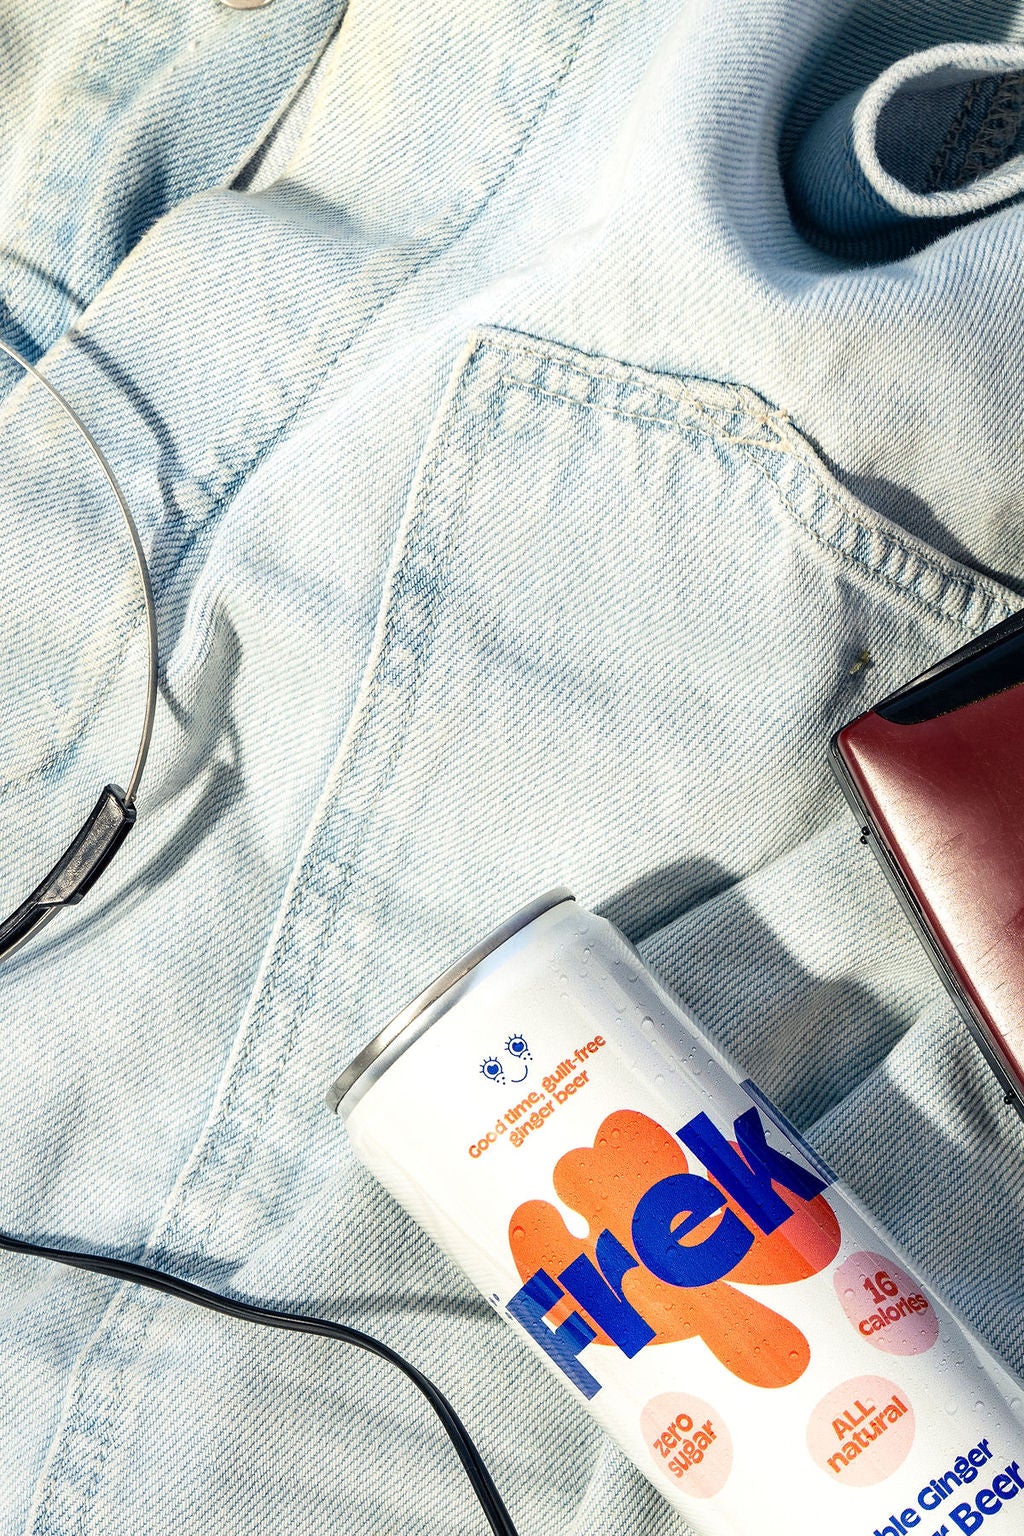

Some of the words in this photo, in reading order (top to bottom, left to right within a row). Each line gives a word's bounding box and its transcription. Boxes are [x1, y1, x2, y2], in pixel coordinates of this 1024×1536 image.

[503, 1091, 546, 1125] time,
[541, 1035, 606, 1093] guilt-free
[509, 1100, 555, 1148] ginger
[552, 1070, 590, 1105] beer
[505, 1106, 829, 1401] Frek
[858, 1292, 928, 1336] calories
[863, 1271, 898, 1305] 16
[653, 1413, 693, 1458] zero
[668, 1419, 717, 1478] sugar
[827, 1395, 908, 1473] natural
[831, 1399, 876, 1441] ALL
[918, 1438, 993, 1511] Ginger
